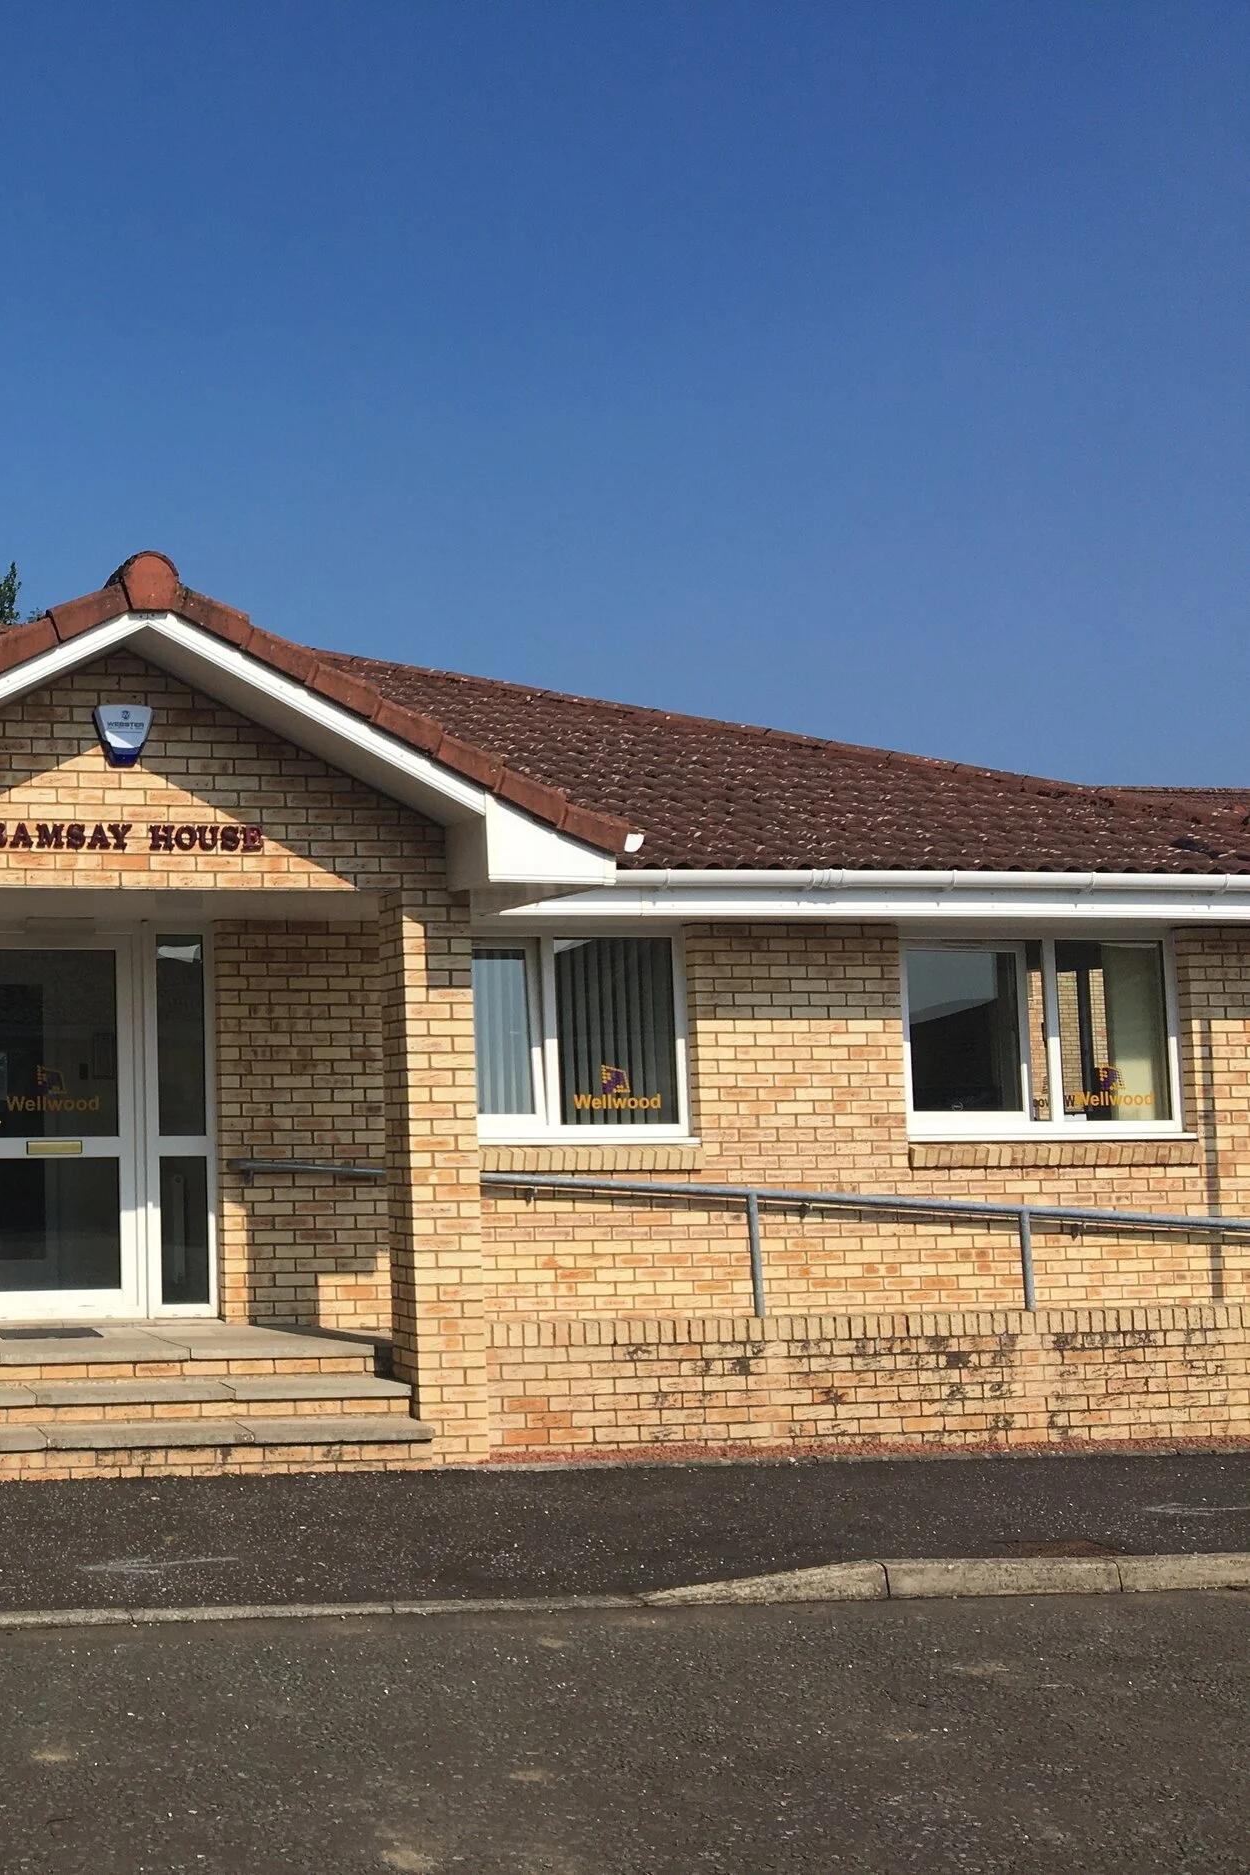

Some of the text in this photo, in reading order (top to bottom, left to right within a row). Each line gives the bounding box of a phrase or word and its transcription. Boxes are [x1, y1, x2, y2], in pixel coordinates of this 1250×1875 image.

[149, 824, 264, 853] HOUSE
[6, 1095, 100, 1112] Wellwood
[573, 1093, 661, 1109] Wellwood
[1074, 1090, 1155, 1107] Wellwood
